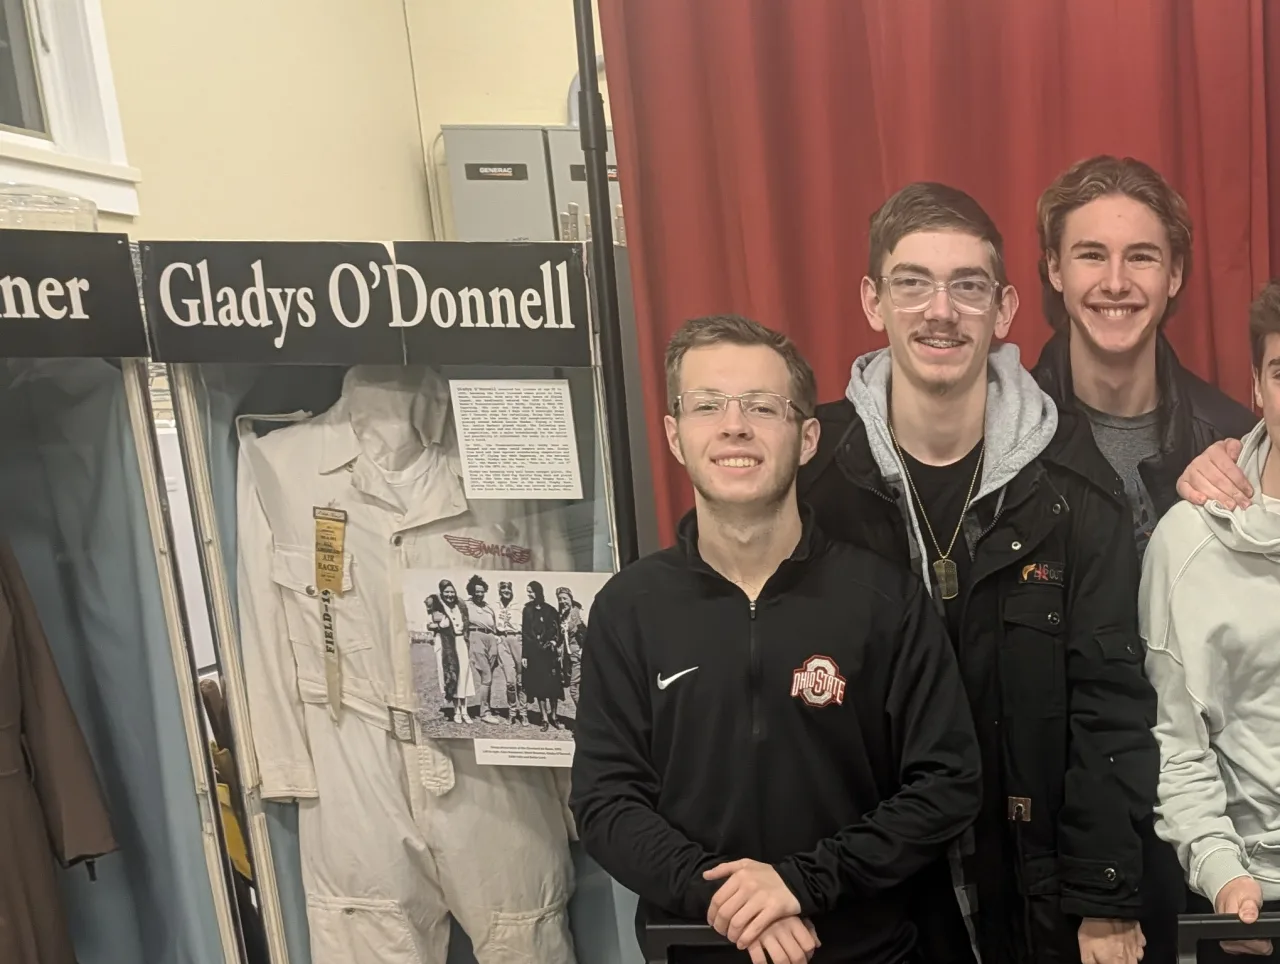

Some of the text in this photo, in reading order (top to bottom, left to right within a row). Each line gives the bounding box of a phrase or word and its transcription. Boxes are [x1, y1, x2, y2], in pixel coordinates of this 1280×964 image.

[0, 275, 90, 319] ner
[159, 258, 576, 348] Gladys O'Donnell
[317, 562, 340, 572] RACES
[322, 554, 335, 562] AIR
[790, 669, 846, 705] OHIO STATE
